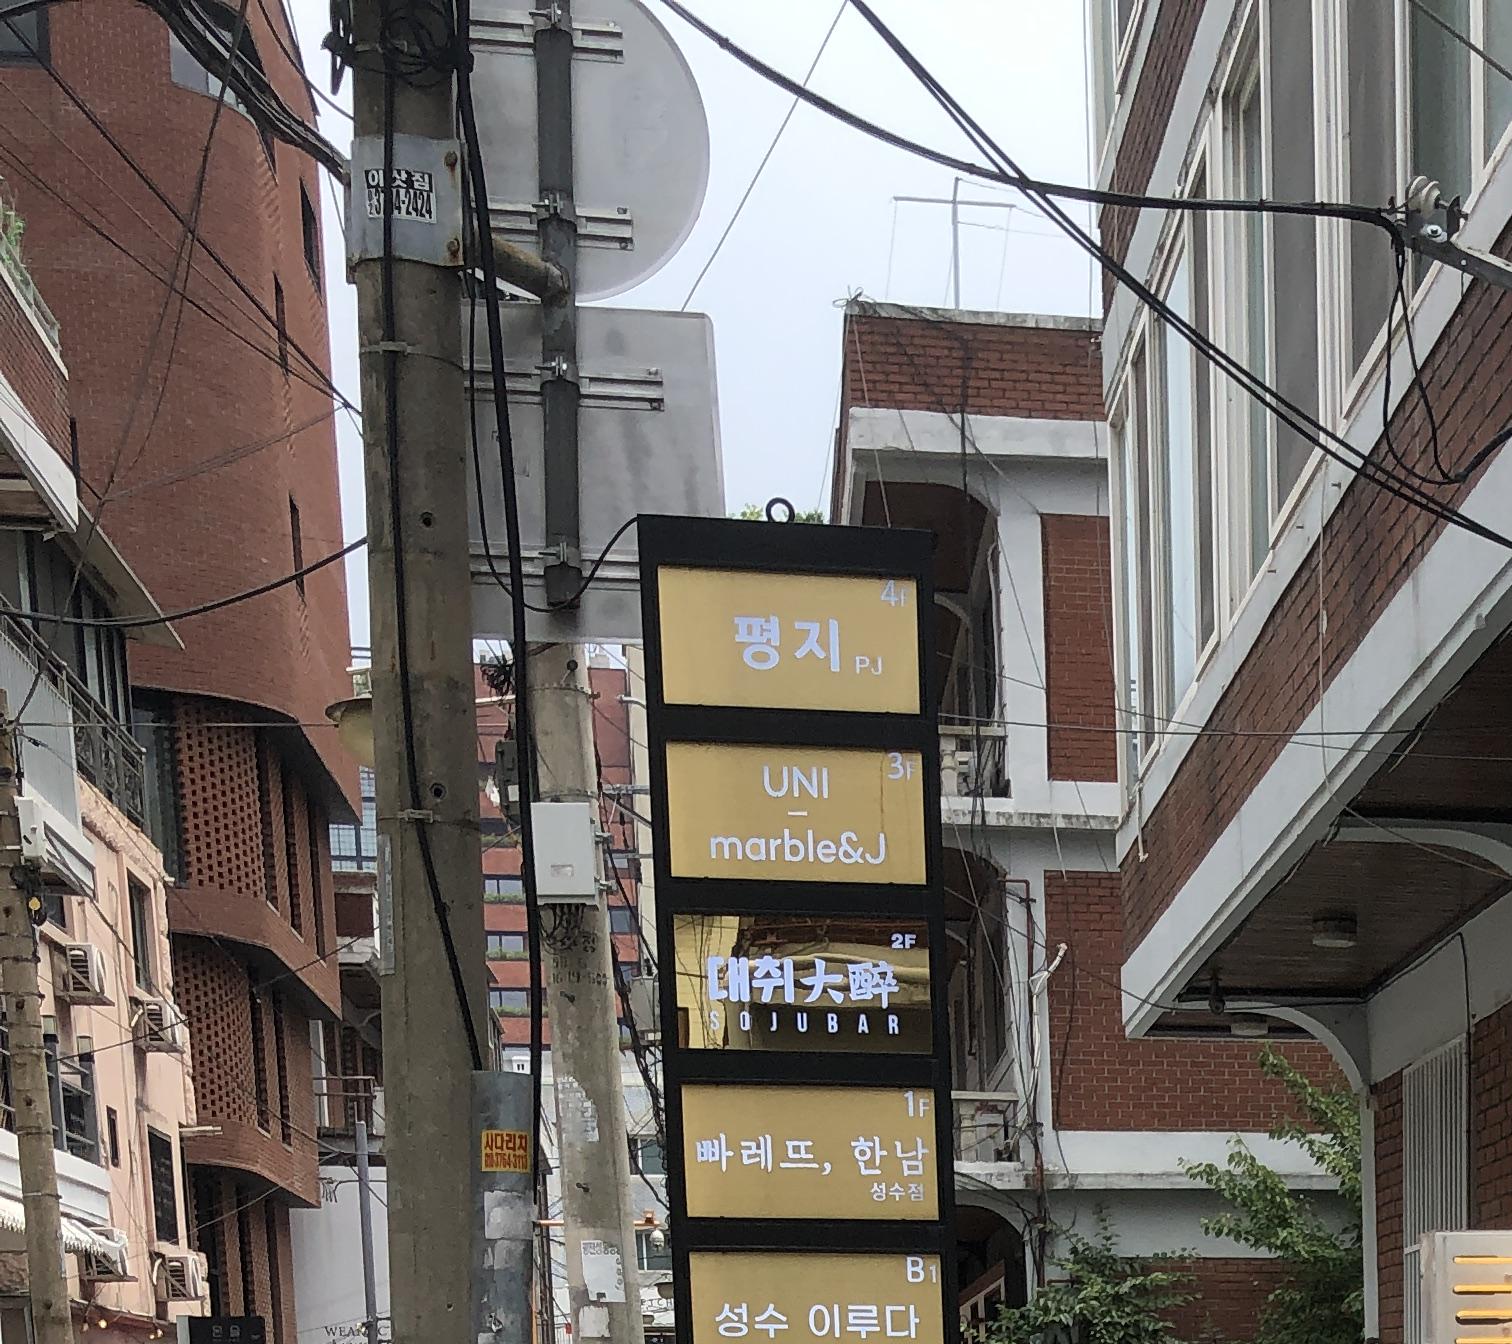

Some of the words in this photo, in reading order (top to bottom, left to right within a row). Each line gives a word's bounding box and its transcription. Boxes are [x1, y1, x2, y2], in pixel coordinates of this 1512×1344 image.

[855, 656, 883, 675] PJ
[887, 752, 916, 781] 3F
[762, 765, 829, 800] UNI
[710, 828, 888, 865] marble&J
[891, 933, 916, 949] 2F
[903, 1090, 931, 1118] 1F
[851, 1135, 930, 1177] 한남
[870, 1182, 925, 1202] 성수점
[905, 1256, 937, 1284] B1
[714, 1302, 789, 1339] 성수
[809, 1304, 921, 1339] 이루다
